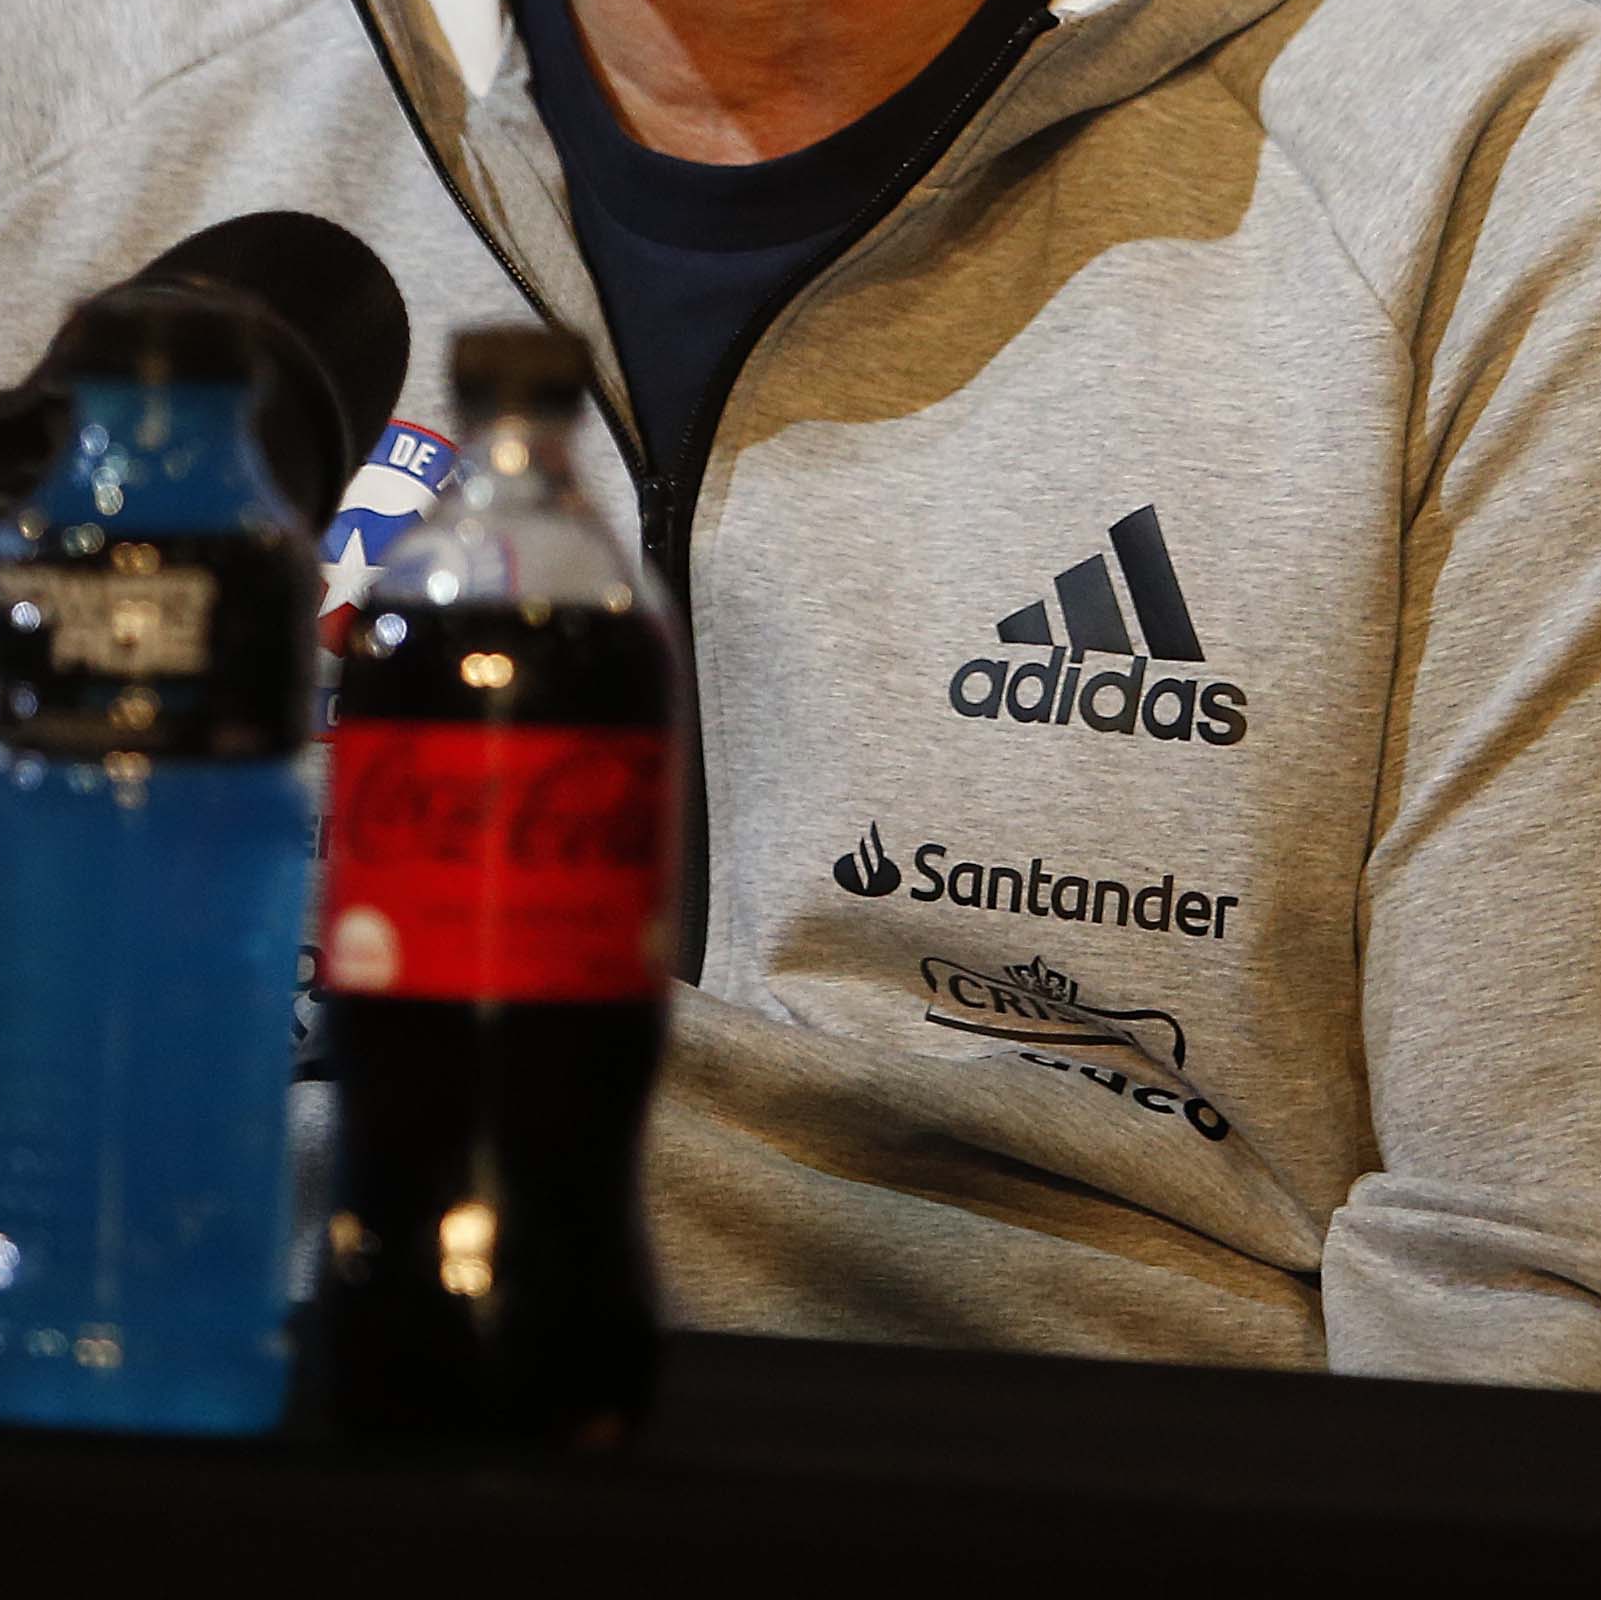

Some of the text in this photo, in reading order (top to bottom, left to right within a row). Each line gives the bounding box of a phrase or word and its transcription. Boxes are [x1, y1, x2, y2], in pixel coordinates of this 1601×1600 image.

[388, 433, 437, 477] DE
[948, 645, 1247, 747] adidas
[910, 842, 1239, 940] Santander
